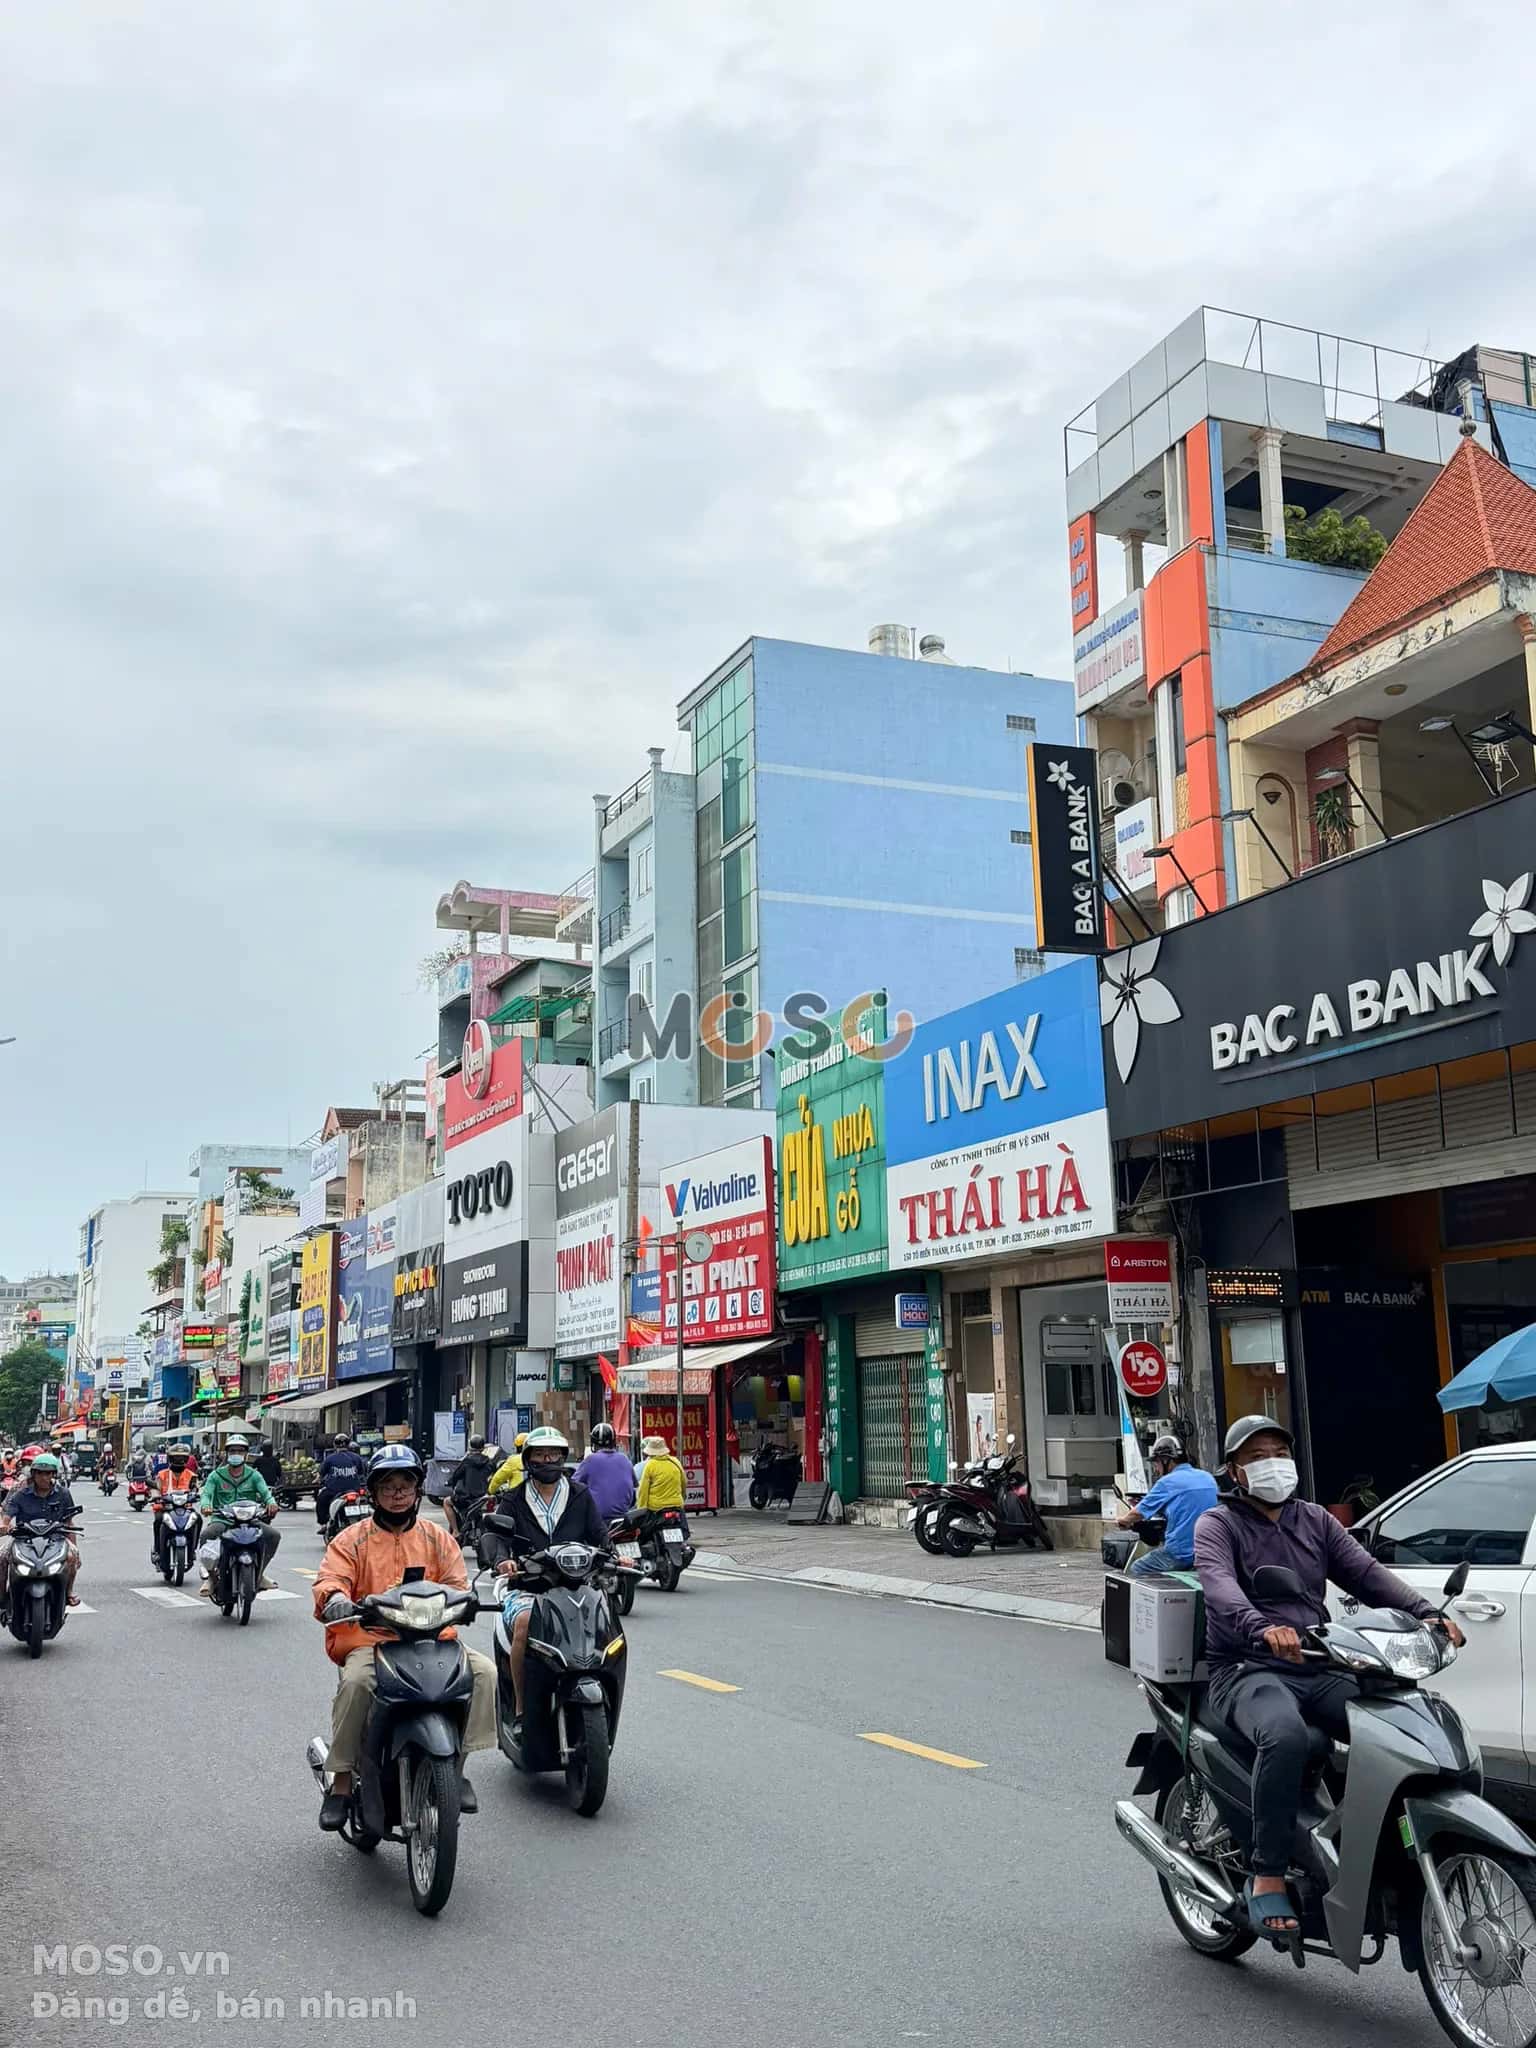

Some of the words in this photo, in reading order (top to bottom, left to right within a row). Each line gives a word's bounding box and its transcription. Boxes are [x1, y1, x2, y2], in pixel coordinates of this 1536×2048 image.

[1067, 784, 1090, 851] BANK
[1071, 858, 1091, 878] A
[1210, 1004, 1298, 1070] BAC
[1305, 992, 1343, 1045] A
[1347, 942, 1497, 1032] BANK
[923, 1012, 1047, 1124] INAX
[832, 1103, 876, 1163] NHỰA
[447, 1160, 513, 1225] TOTO
[691, 1172, 757, 1212] Valvoline
[783, 1094, 829, 1247] CỬA
[899, 1164, 1006, 1245] THÁI
[1016, 1142, 1092, 1224] HÀ
[836, 1167, 860, 1233] GỖ
[463, 1264, 496, 1284] SHOWROOM
[709, 1246, 760, 1293] PHÁT
[1123, 1259, 1167, 1267] ARISTON
[902, 1312, 928, 1321] MOLY
[903, 1303, 926, 1312] LIQUI
[1113, 1296, 1146, 1307] THÁI
[1151, 1296, 1170, 1307] HÀ
[1302, 1290, 1330, 1303] ATM
[1344, 1292, 1370, 1304] BAC
[1372, 1292, 1381, 1305] A
[1383, 1292, 1416, 1305] BANK
